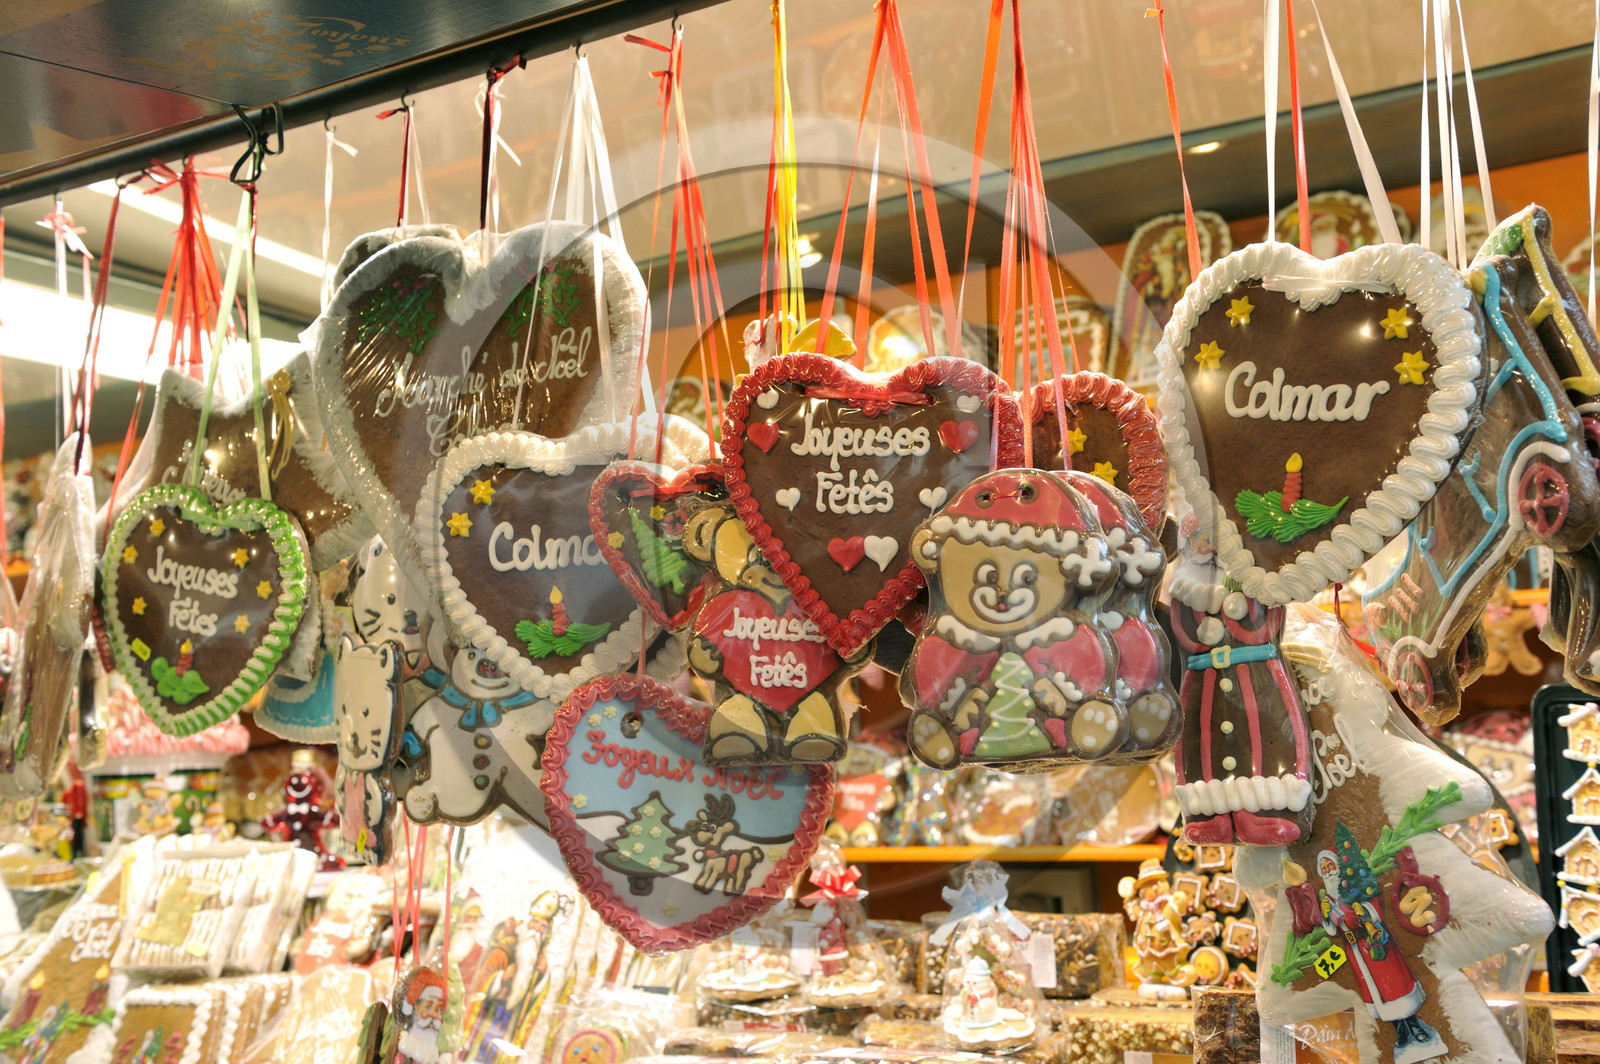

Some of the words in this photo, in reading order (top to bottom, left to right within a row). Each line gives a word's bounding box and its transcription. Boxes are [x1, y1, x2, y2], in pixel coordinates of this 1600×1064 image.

[1225, 361, 1390, 421] Colmar
[790, 413, 931, 471] Joyeuses
[147, 545, 239, 599] Joyeuses
[488, 521, 608, 572] Colma
[582, 729, 695, 789] Joyeux
[702, 766, 787, 800] Noël
[1298, 1024, 1341, 1050] Pain
